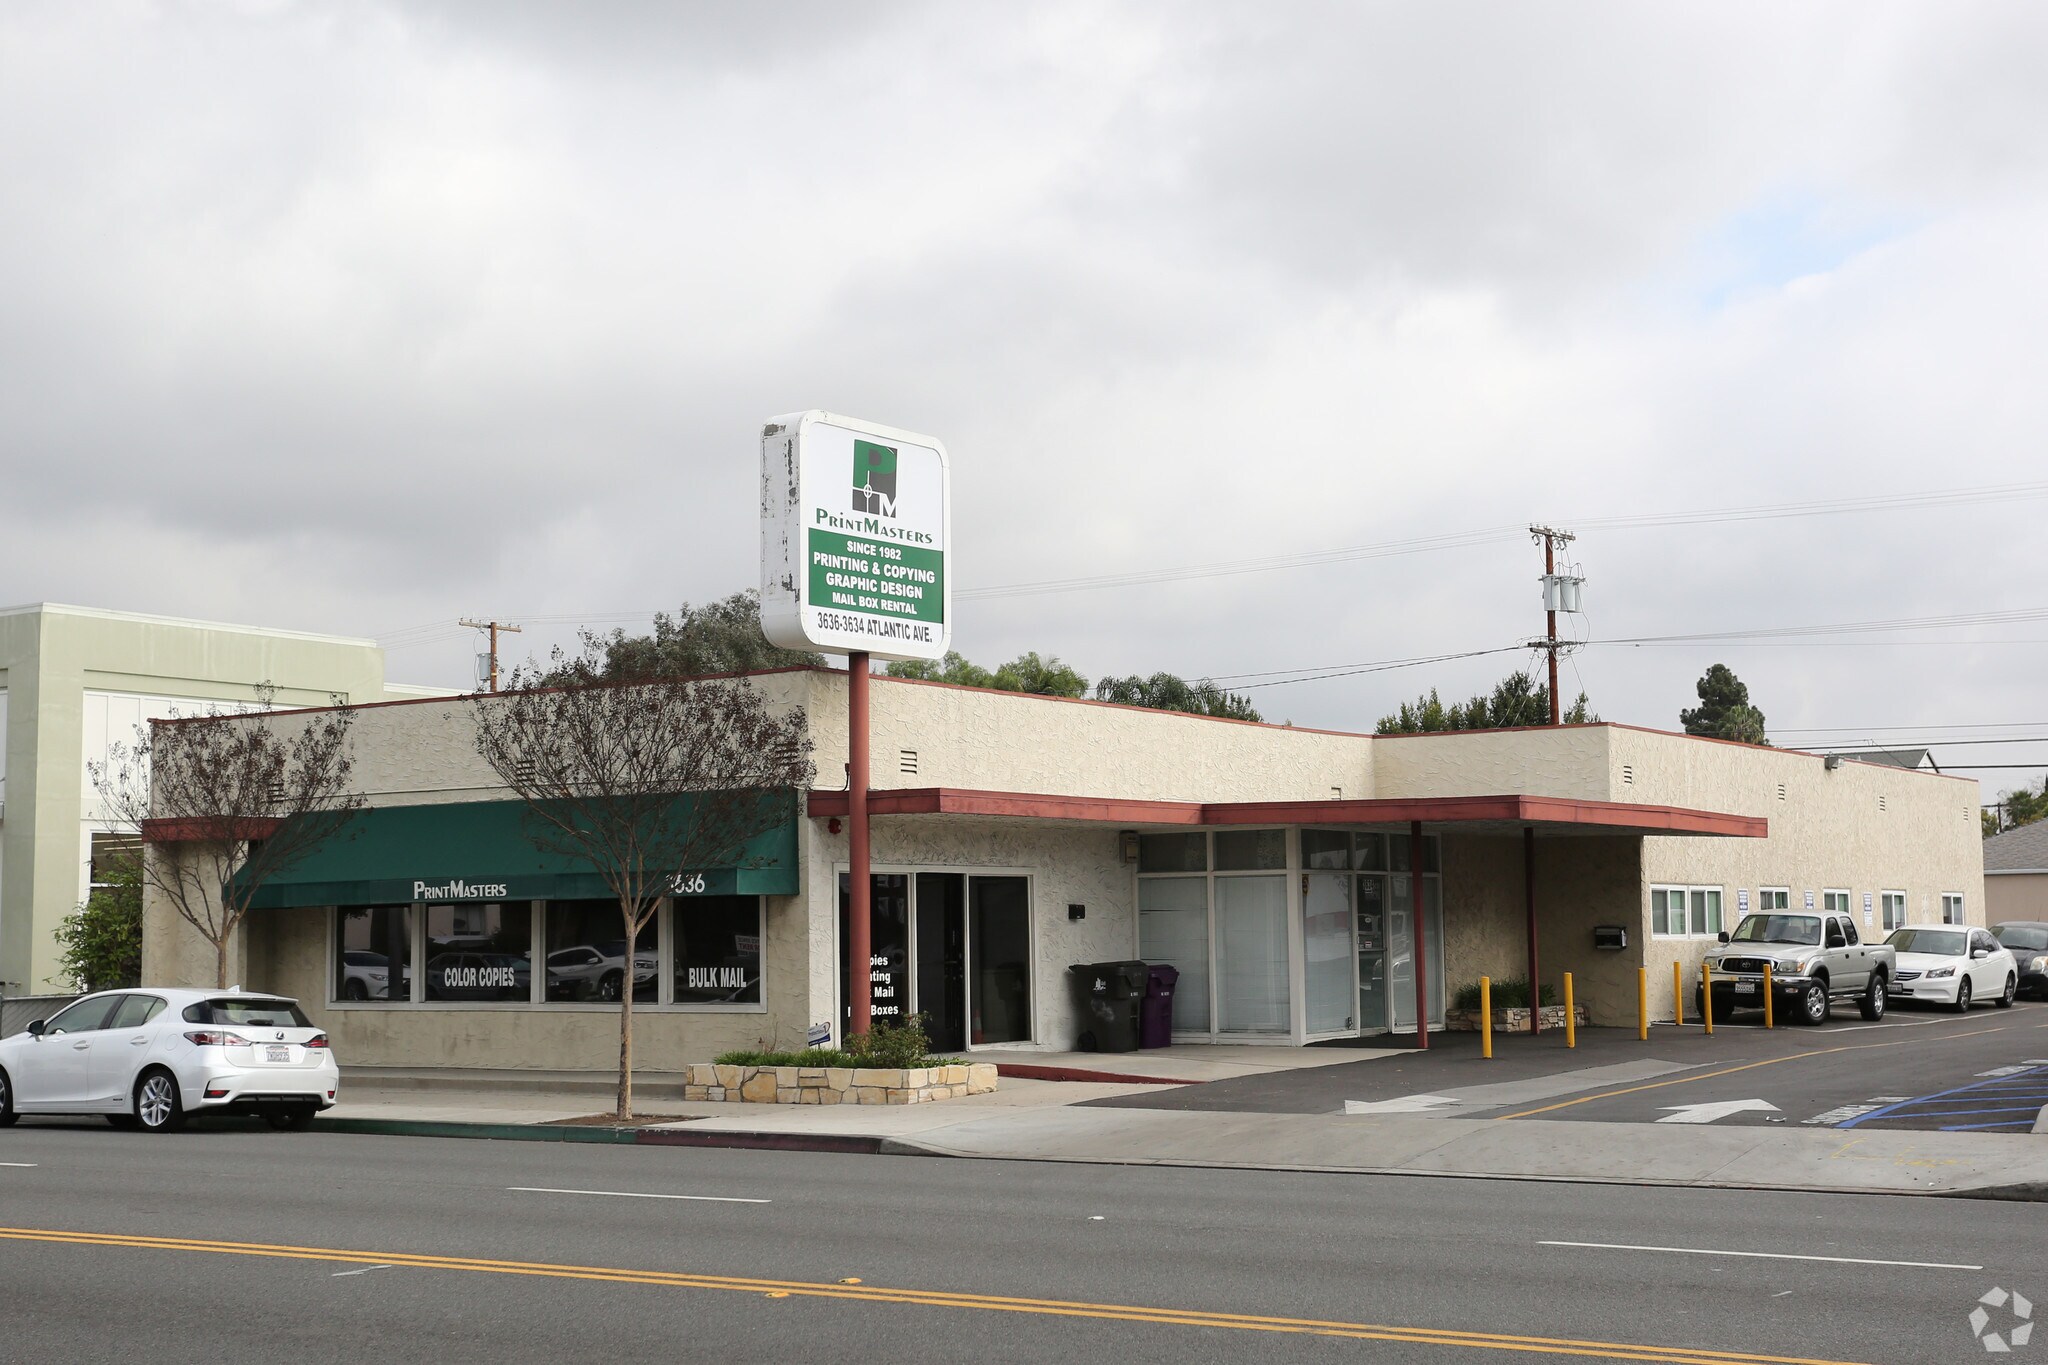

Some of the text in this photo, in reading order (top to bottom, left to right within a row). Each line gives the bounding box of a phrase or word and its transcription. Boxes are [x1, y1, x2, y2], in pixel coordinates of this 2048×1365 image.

[847, 541, 901, 560] SINCE 1982
[814, 552, 935, 583] PRINTING & COPYING
[826, 572, 922, 599] GRAPHIC DESIGN
[832, 592, 917, 614] MAIL BOX RENTAL
[818, 612, 932, 642] 3636-3634 ATLANTIC AVE.
[870, 954, 888, 968] pies
[445, 967, 514, 986] COLOR COPIES
[689, 968, 746, 988] BULK MAIL
[875, 986, 893, 997] Mail
[871, 1005, 898, 1015] Boxes
